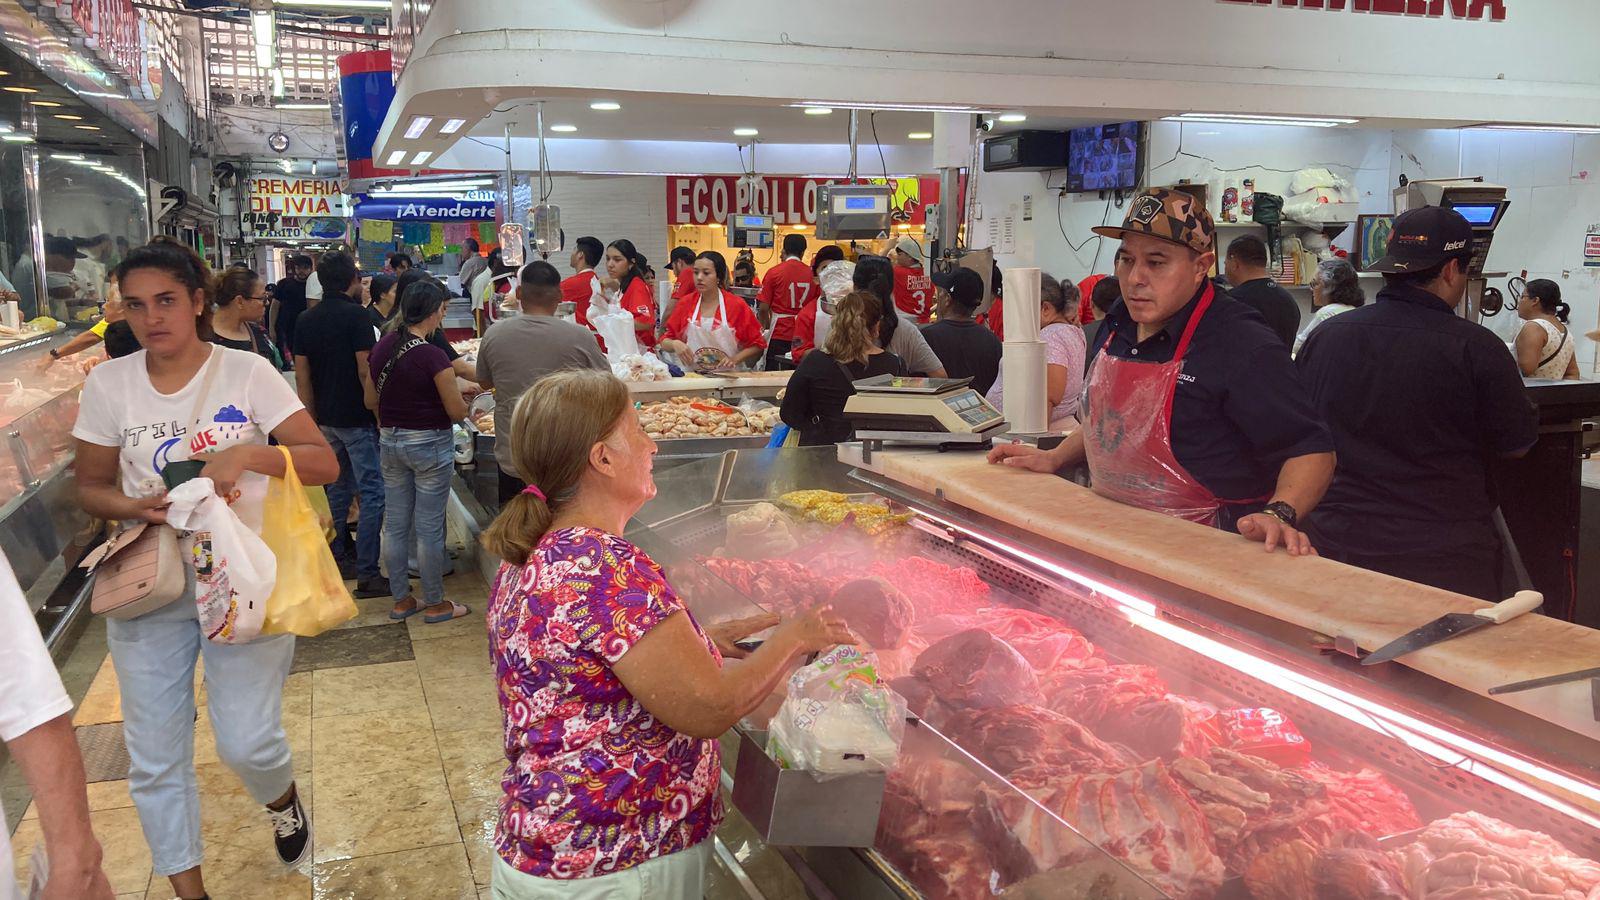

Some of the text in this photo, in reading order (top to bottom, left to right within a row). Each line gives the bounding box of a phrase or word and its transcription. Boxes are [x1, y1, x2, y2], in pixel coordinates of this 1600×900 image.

[676, 178, 834, 224] ECO POLLO
[1443, 239, 1467, 251] telcel
[788, 282, 811, 309] 17
[912, 290, 926, 315] 3
